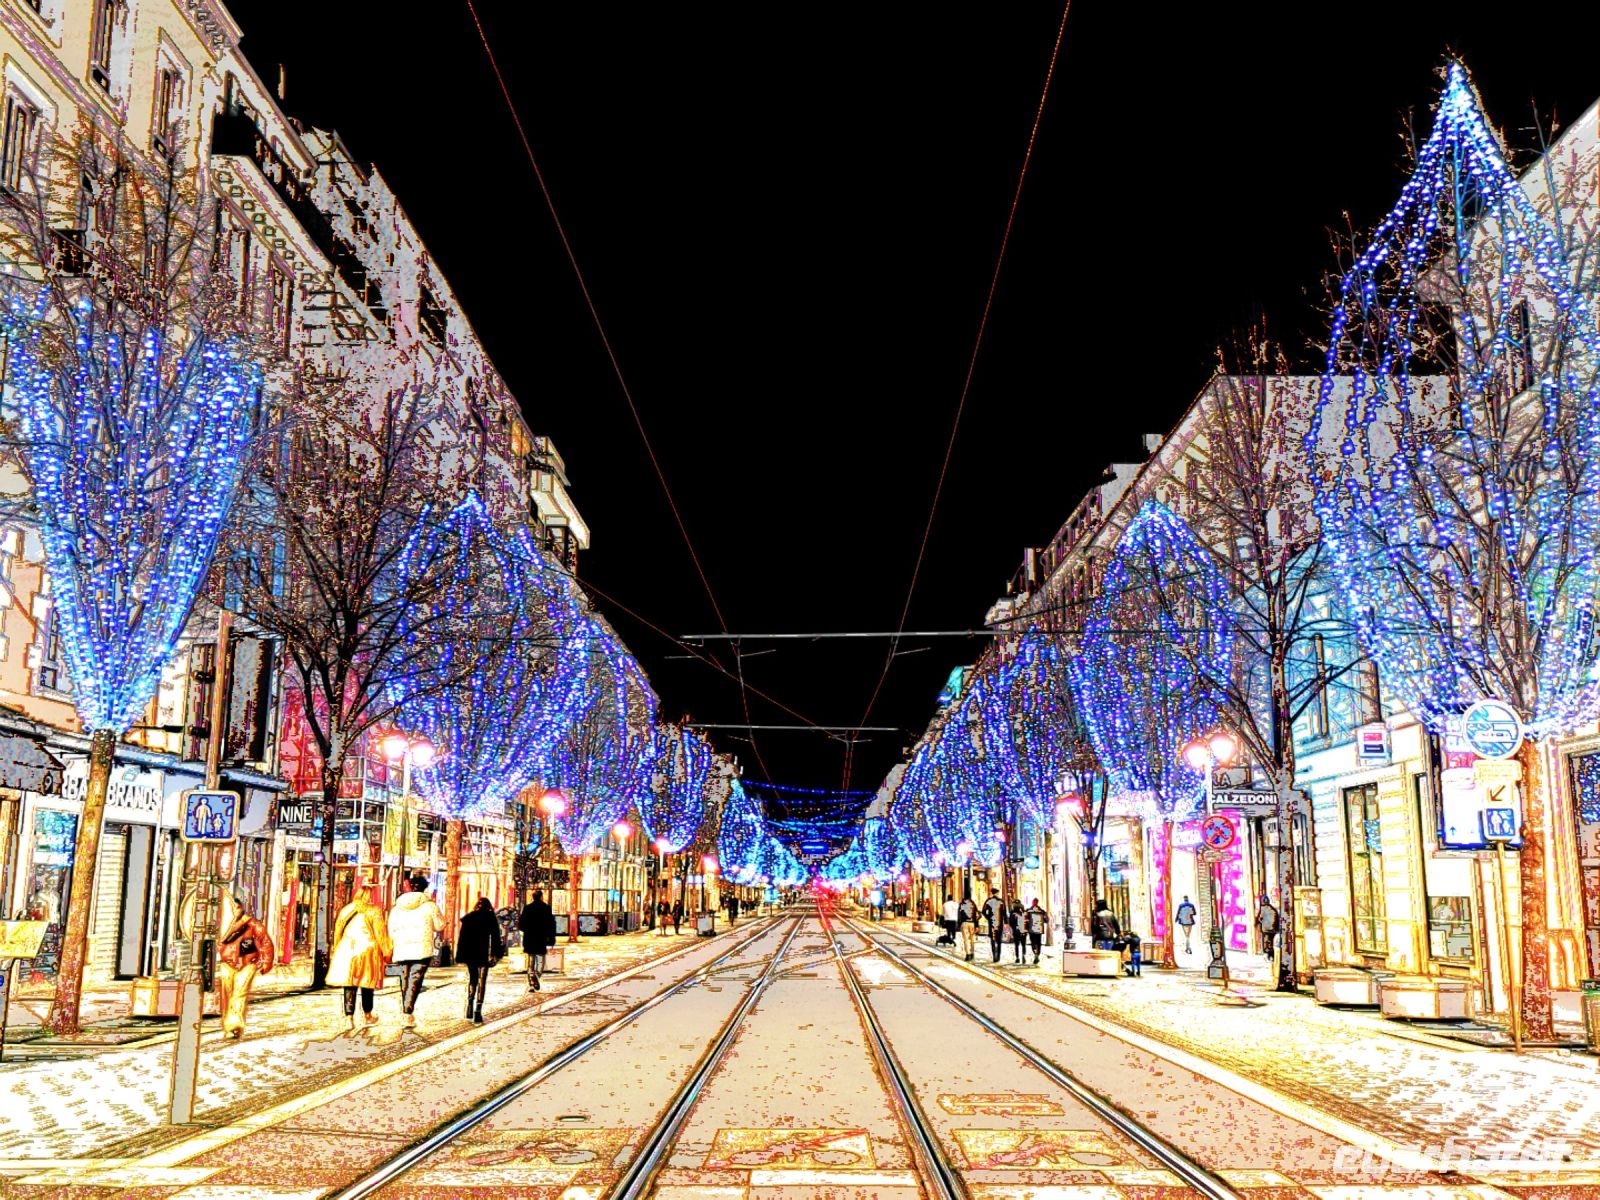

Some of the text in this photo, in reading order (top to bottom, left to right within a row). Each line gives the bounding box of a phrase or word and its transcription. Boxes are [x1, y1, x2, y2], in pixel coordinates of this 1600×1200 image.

[106, 782, 160, 811] BRANDS
[1212, 792, 1277, 804] ALZEDONI
[279, 804, 313, 823] NINE
